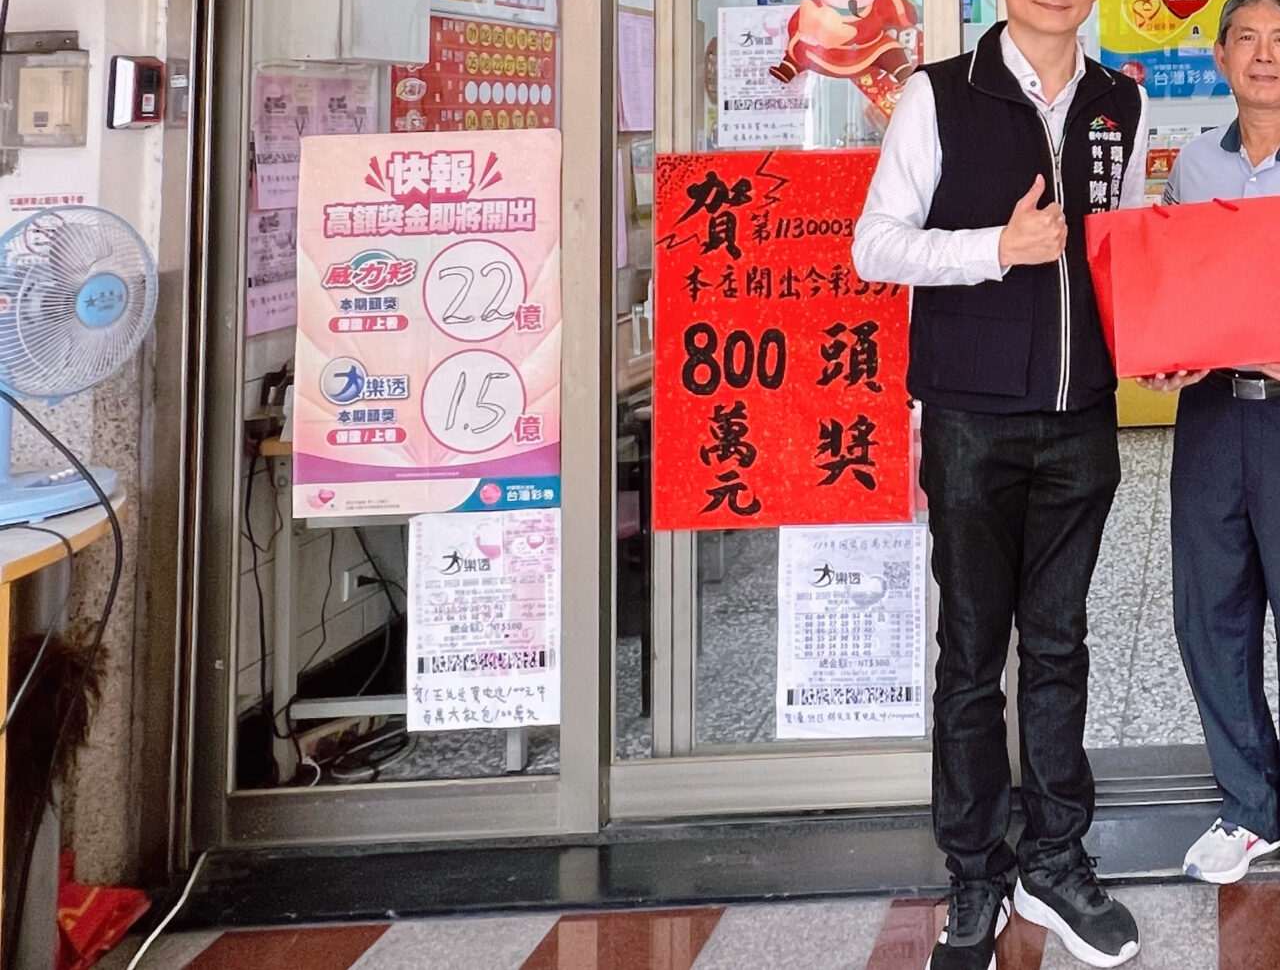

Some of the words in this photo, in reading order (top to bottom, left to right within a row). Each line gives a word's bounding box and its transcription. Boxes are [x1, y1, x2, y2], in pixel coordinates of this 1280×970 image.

[389, 152, 474, 195] 快報
[325, 199, 535, 237] 高額獎金即將開出
[674, 170, 752, 260] 賀
[323, 261, 416, 288] 威力彩
[439, 261, 515, 324] 22
[514, 303, 543, 331] 億
[331, 365, 408, 399] 大樂透
[681, 322, 787, 396] 800
[445, 371, 510, 434] 1.5
[514, 415, 542, 442] 億
[815, 319, 884, 491] 頭獎
[698, 400, 762, 517] 萬元
